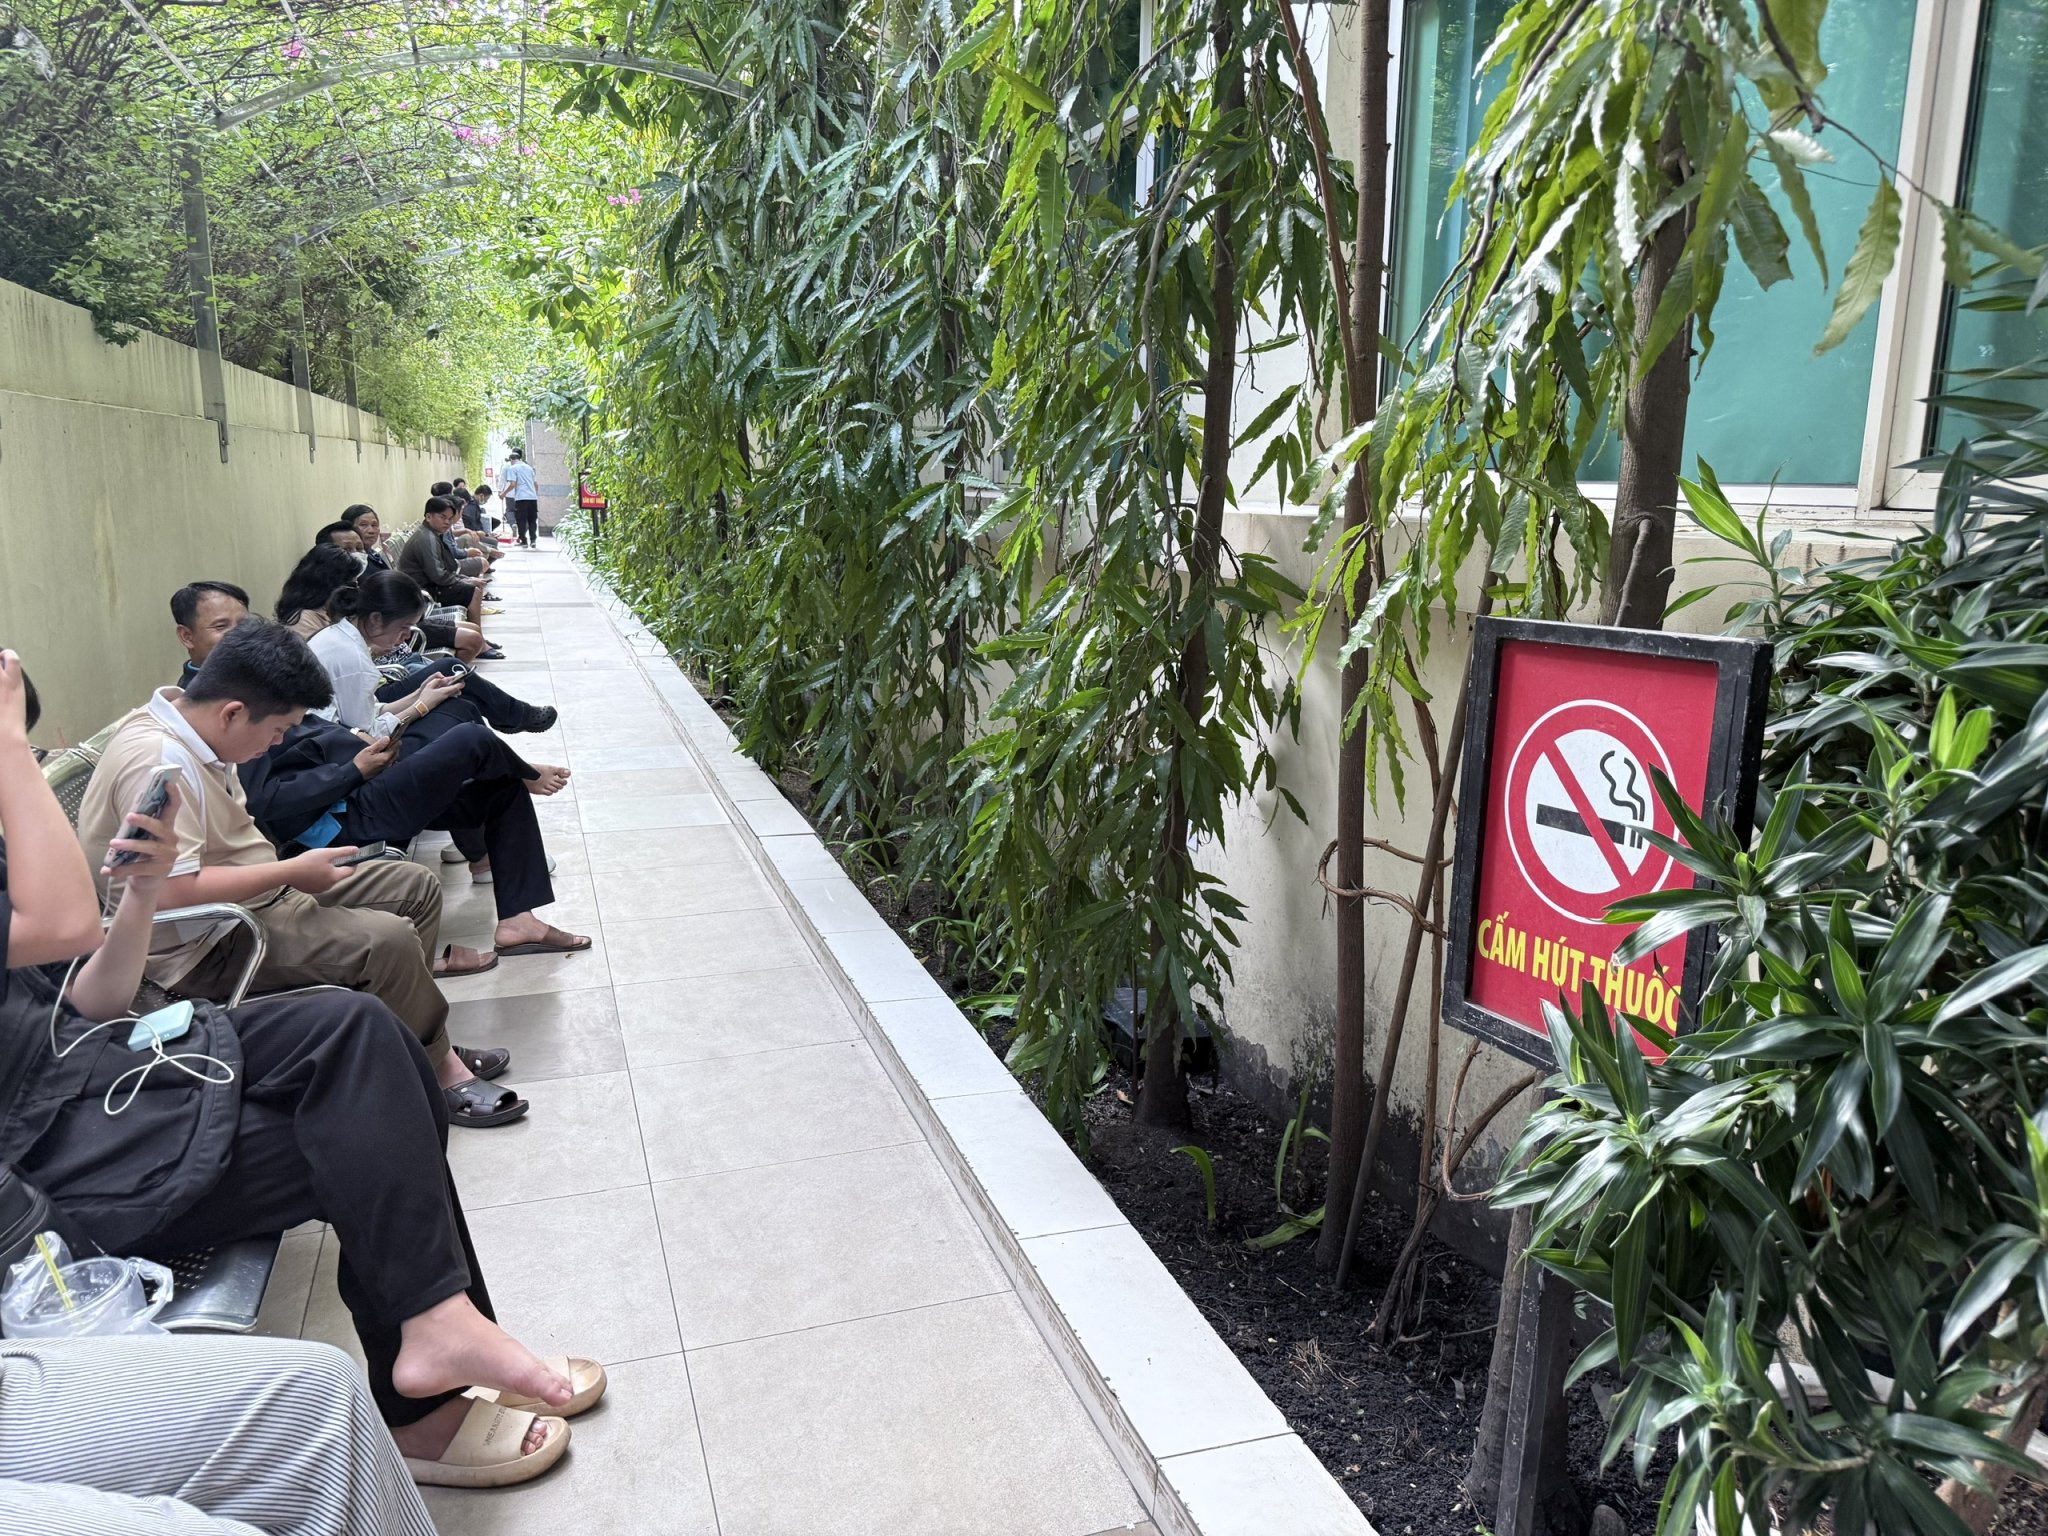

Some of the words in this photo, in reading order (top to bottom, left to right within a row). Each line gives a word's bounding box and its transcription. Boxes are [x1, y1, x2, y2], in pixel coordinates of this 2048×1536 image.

[1477, 911, 1527, 973] CẤM
[1532, 935, 1584, 993] HÚT
[1589, 956, 1681, 1032] THUỐC
